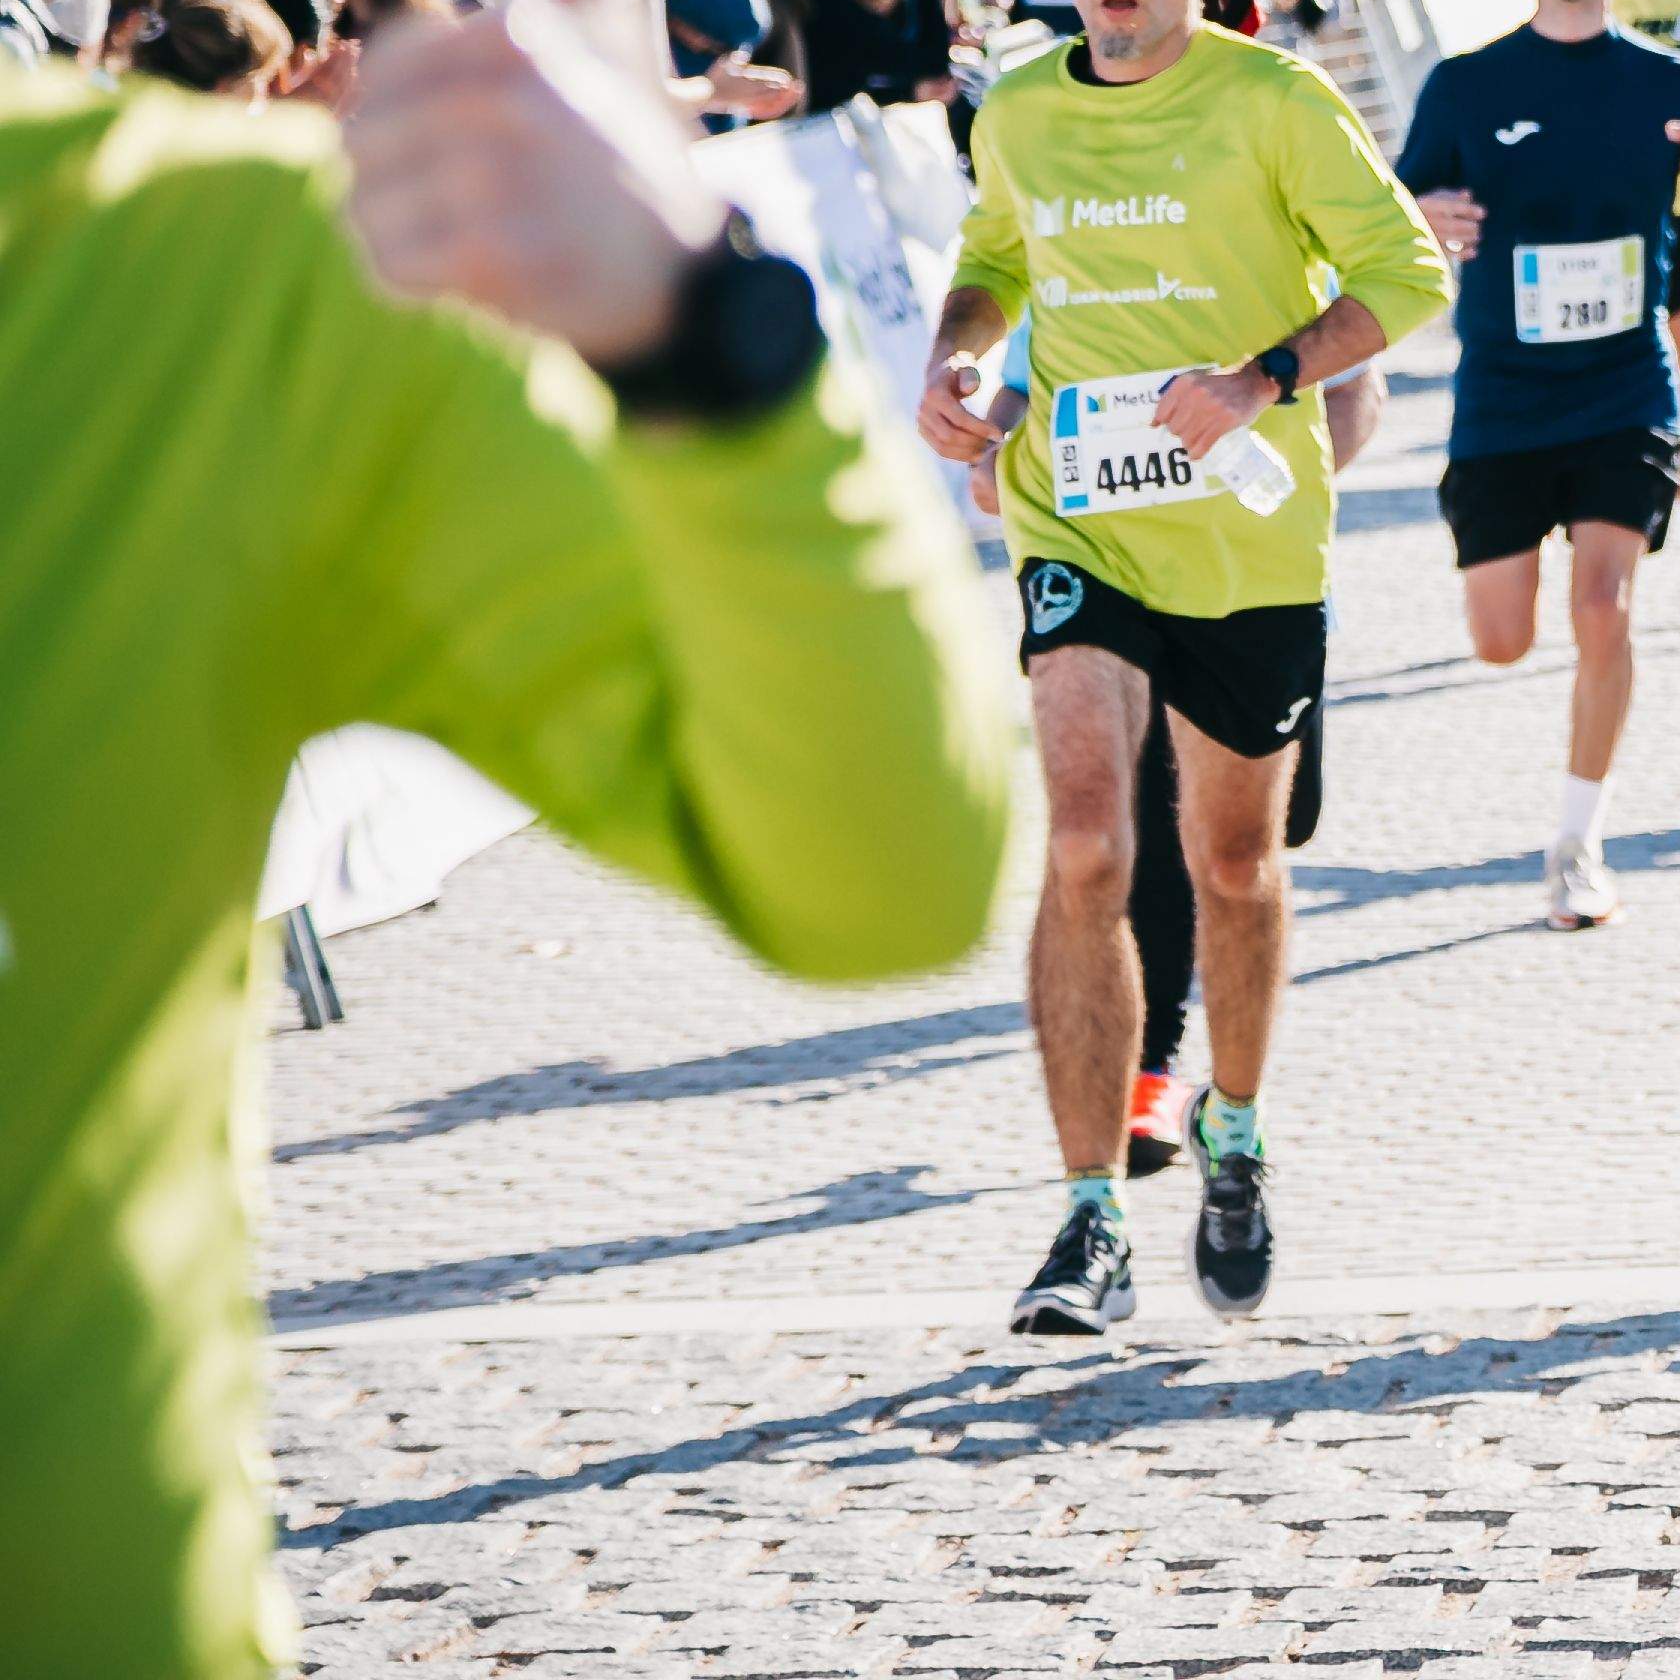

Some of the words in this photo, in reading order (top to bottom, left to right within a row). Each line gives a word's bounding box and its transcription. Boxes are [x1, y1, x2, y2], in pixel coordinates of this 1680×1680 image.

[1072, 195, 1186, 228] MetLife
[1112, 389, 1160, 409] MetL
[1098, 447, 1192, 495] 4446
